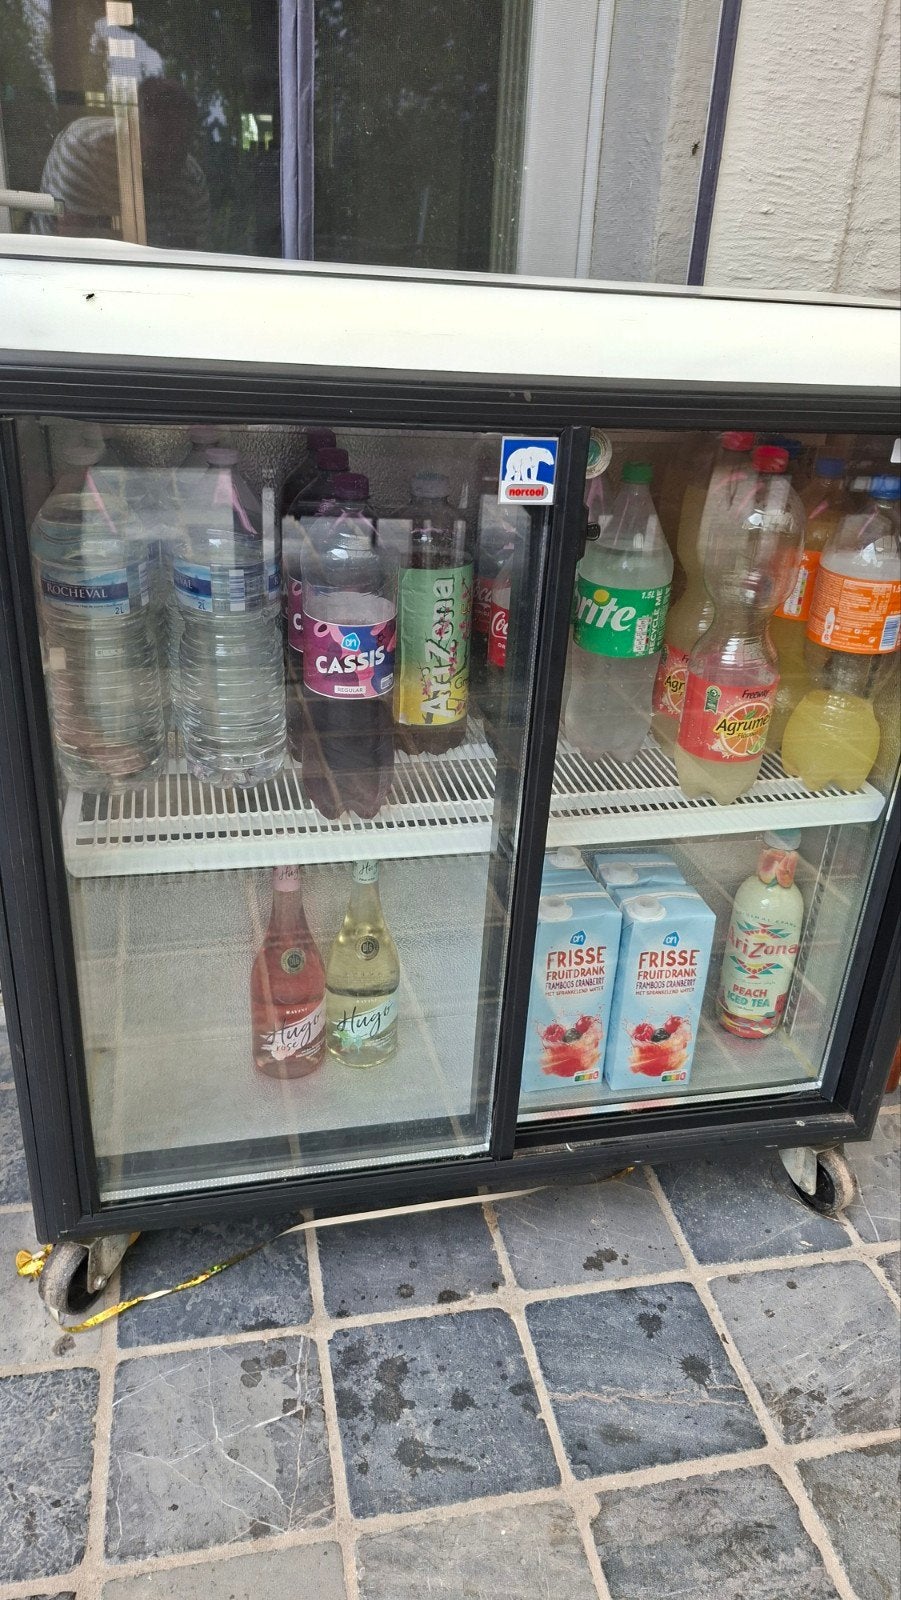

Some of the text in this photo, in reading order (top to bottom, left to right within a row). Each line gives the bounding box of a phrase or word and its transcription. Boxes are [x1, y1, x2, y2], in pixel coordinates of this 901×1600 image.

[509, 487, 544, 496] norcool
[46, 582, 108, 598] ROCHEVAL
[648, 609, 660, 655] RECYCLE
[655, 589, 662, 606] ME
[315, 645, 386, 674] CASSIS
[336, 685, 364, 693] REGULAR
[728, 926, 800, 959] AriZona
[547, 946, 606, 970] FRISSE
[639, 949, 700, 970] FRISSE
[545, 977, 605, 991] FRAMBOOS CRANBERRY
[636, 978, 696, 990] FRAMBOOS CRANBERRY
[733, 984, 768, 998] PEACH
[727, 991, 770, 1008] ICED TEA
[266, 1012, 322, 1046] Hugo
[336, 1003, 393, 1037] Hugo
